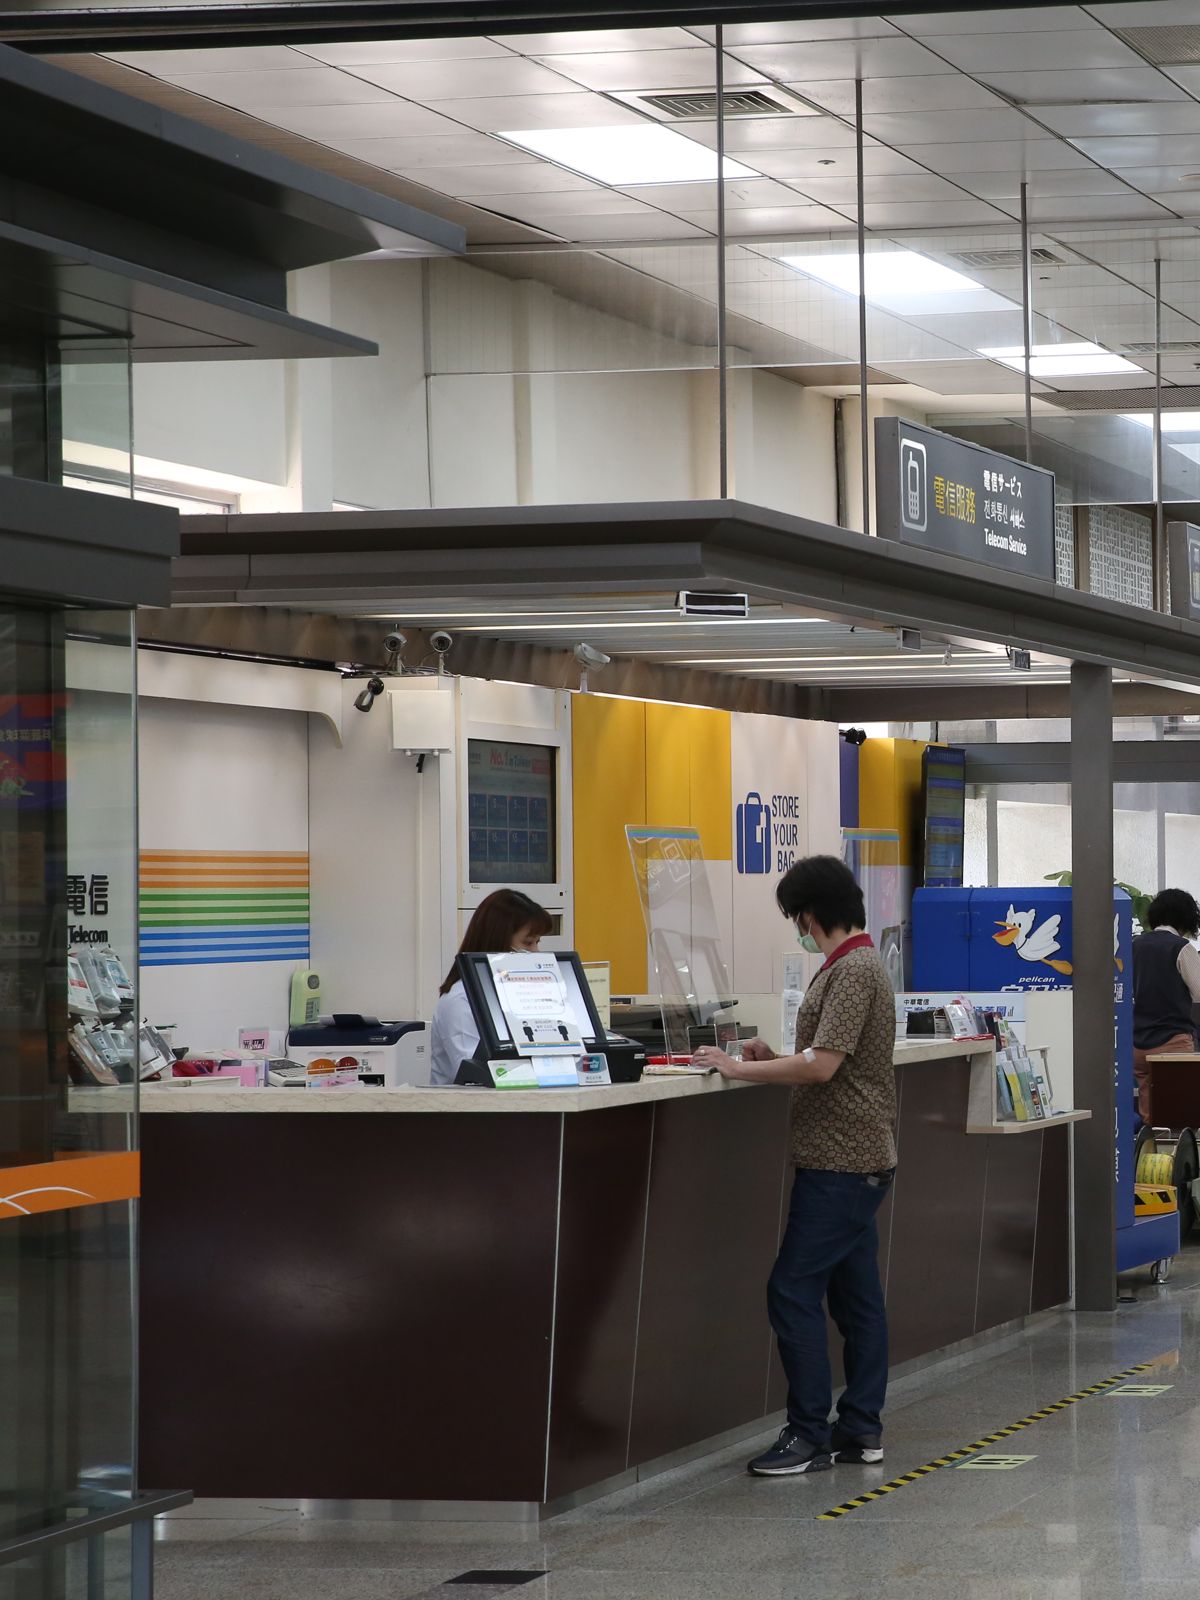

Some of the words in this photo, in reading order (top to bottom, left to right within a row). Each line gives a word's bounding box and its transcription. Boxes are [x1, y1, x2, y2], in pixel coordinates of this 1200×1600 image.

[933, 475, 977, 525] 電信服務
[983, 527, 1009, 551] Telecom
[1008, 534, 1028, 557] Service
[771, 795, 800, 818] STORE
[773, 823, 798, 846] YOUR
[67, 924, 108, 943] Telecom
[1018, 975, 1055, 984] pelican
